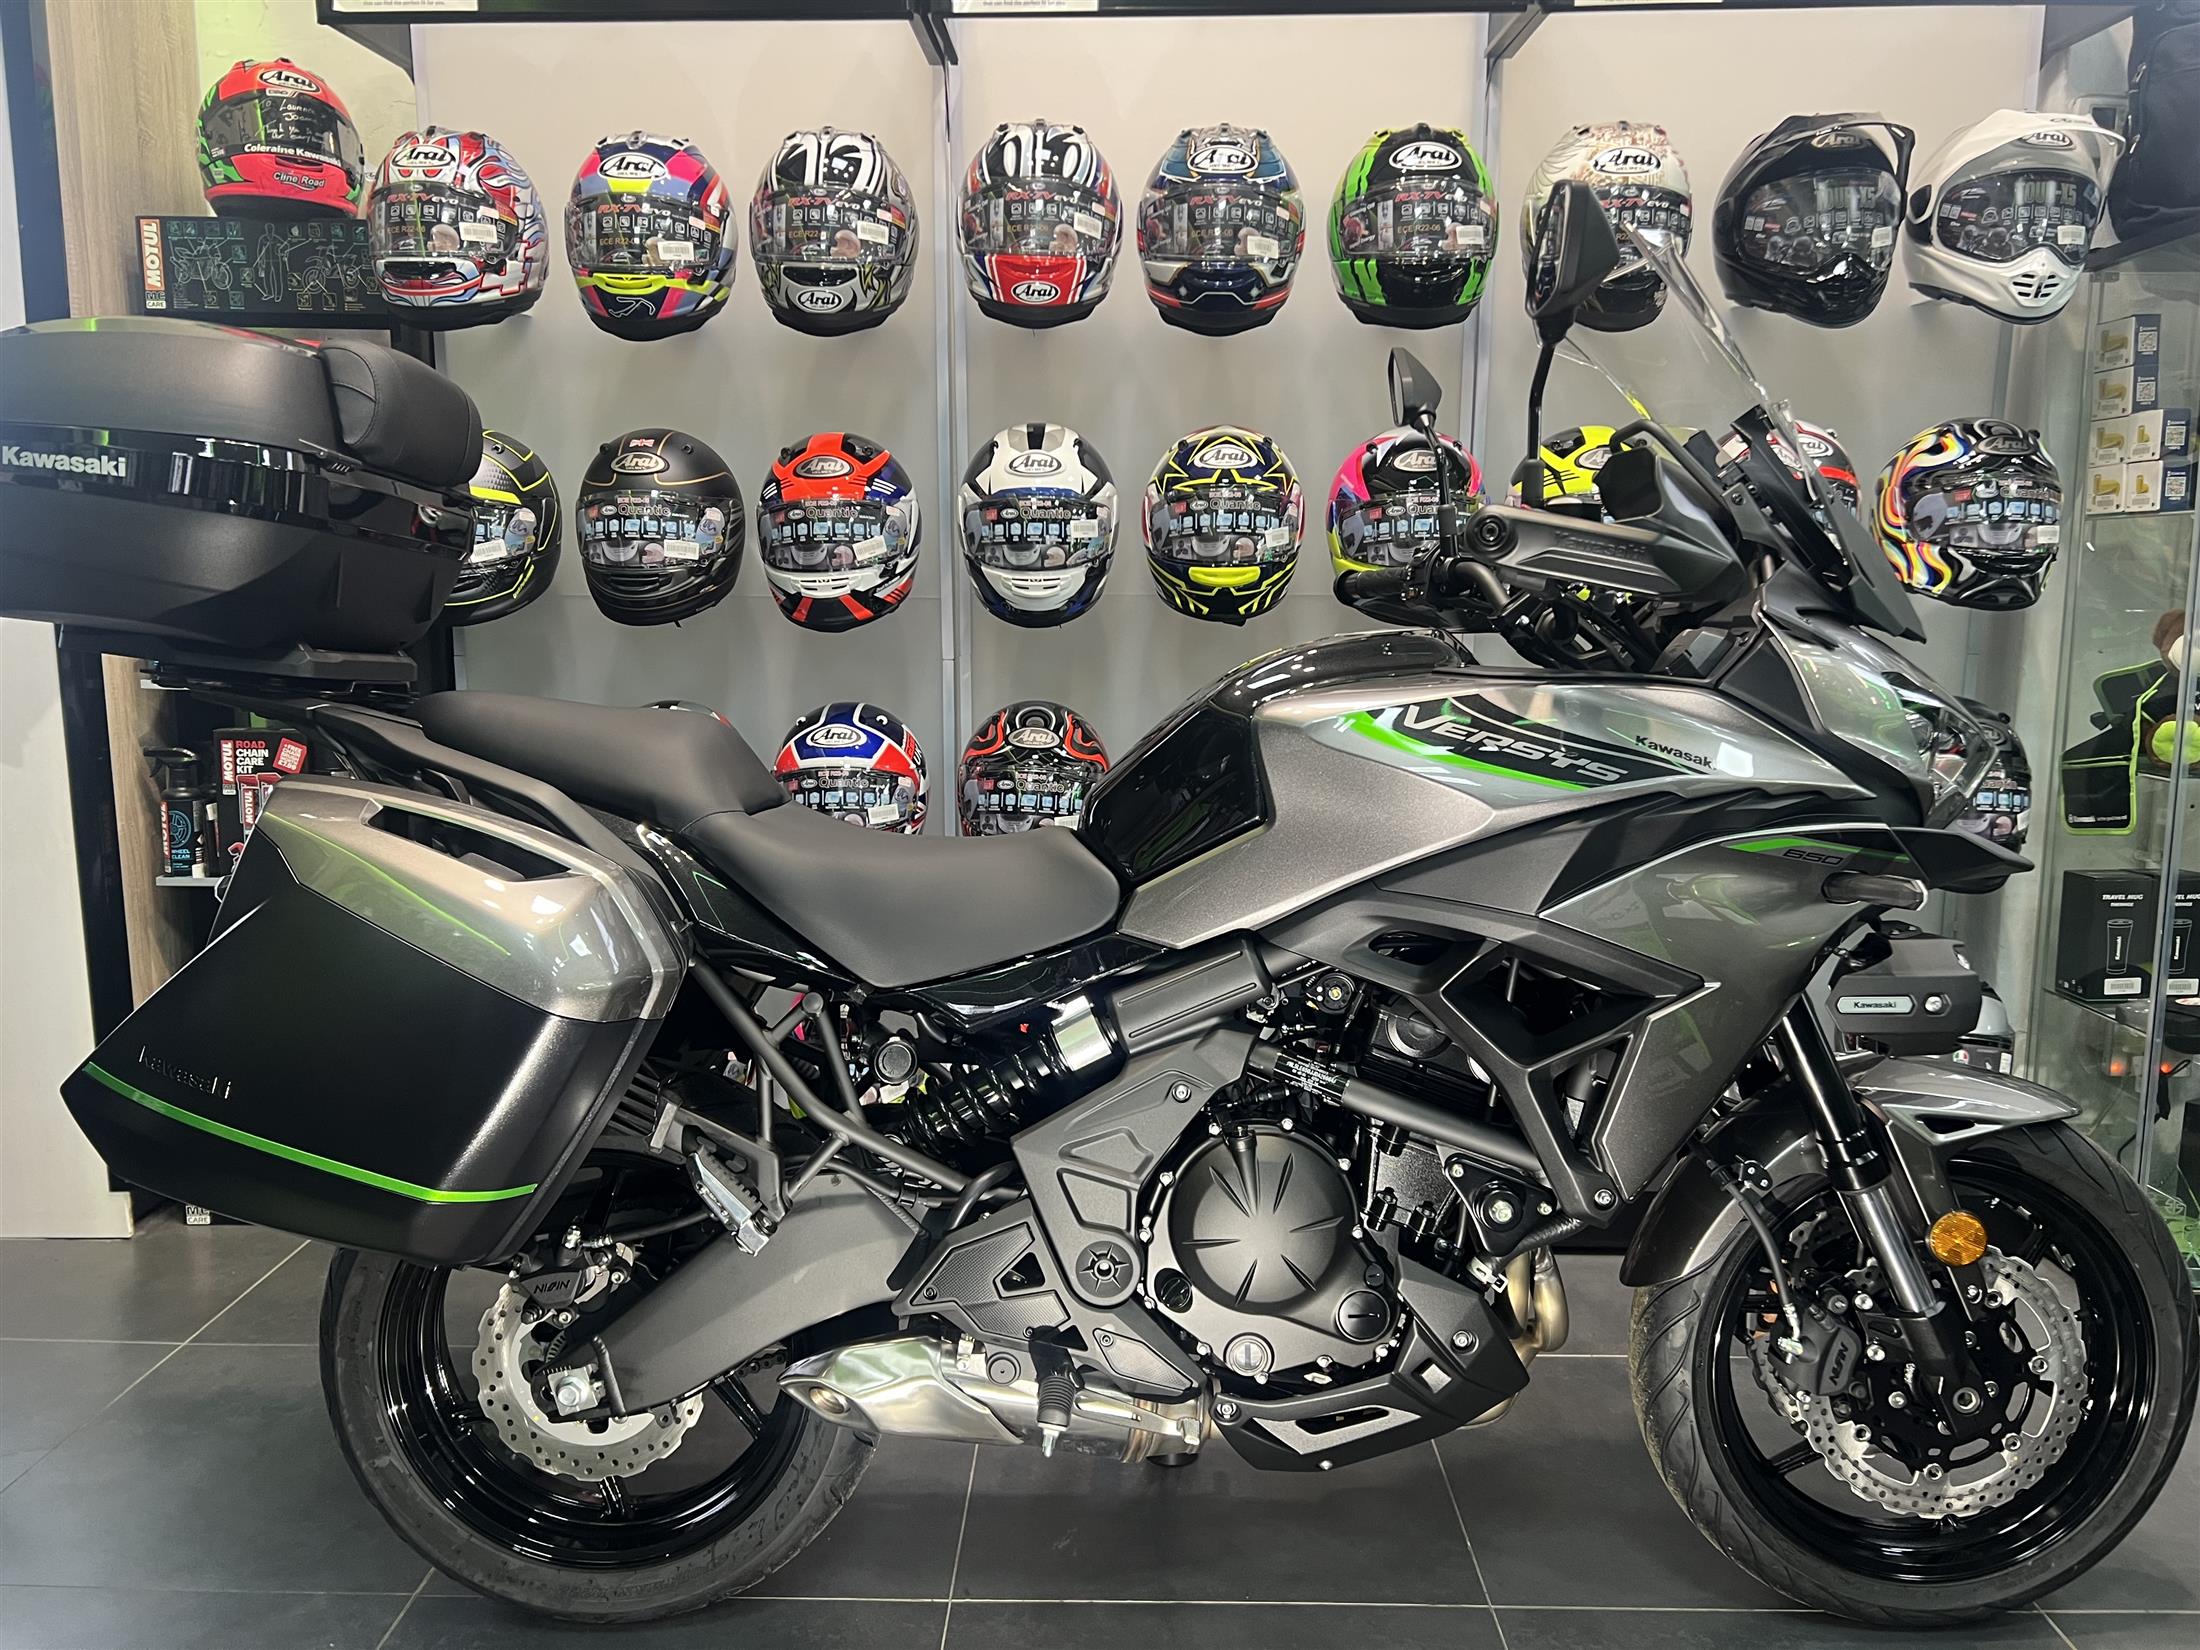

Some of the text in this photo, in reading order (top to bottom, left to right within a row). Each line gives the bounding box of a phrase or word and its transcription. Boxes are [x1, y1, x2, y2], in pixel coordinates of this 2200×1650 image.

[268, 70, 314, 87] Arai
[1812, 134, 1861, 146] Arai
[2029, 131, 2067, 143] Arai
[244, 143, 295, 157] Coleraine
[396, 147, 447, 163] Arai
[1403, 146, 1451, 162] Arai
[602, 156, 656, 173] Arai
[1606, 150, 1655, 166] Arai
[273, 172, 326, 188] Cline Road
[143, 222, 162, 287] MOTUL
[1016, 284, 1054, 297] Arai
[801, 292, 836, 305] Arai
[1986, 437, 2028, 450] Arai
[1, 445, 127, 478] Kawasaki
[617, 453, 658, 468] Arai
[1013, 454, 1055, 469] Arai
[1203, 449, 1246, 462] Arai
[1402, 452, 1437, 465] Ara
[800, 457, 843, 471] Arai
[618, 504, 671, 517] Quantic
[1209, 499, 1262, 511] Quantic
[805, 506, 859, 519] Quantic
[1020, 506, 1072, 519] Quantic
[813, 728, 854, 741] Arai
[1012, 729, 1053, 743] Arai
[235, 740, 266, 749] ROAD
[1402, 704, 1630, 783] VERSYS
[236, 748, 269, 758] CHAIN
[221, 741, 234, 782] MOTUL
[236, 757, 265, 766] CARE
[236, 765, 253, 774] KIT
[244, 791, 254, 824] MOTUL
[1781, 848, 1844, 866] 650
[2126, 893, 2144, 901] MUG
[1853, 1001, 1897, 1009] Kawasaki
